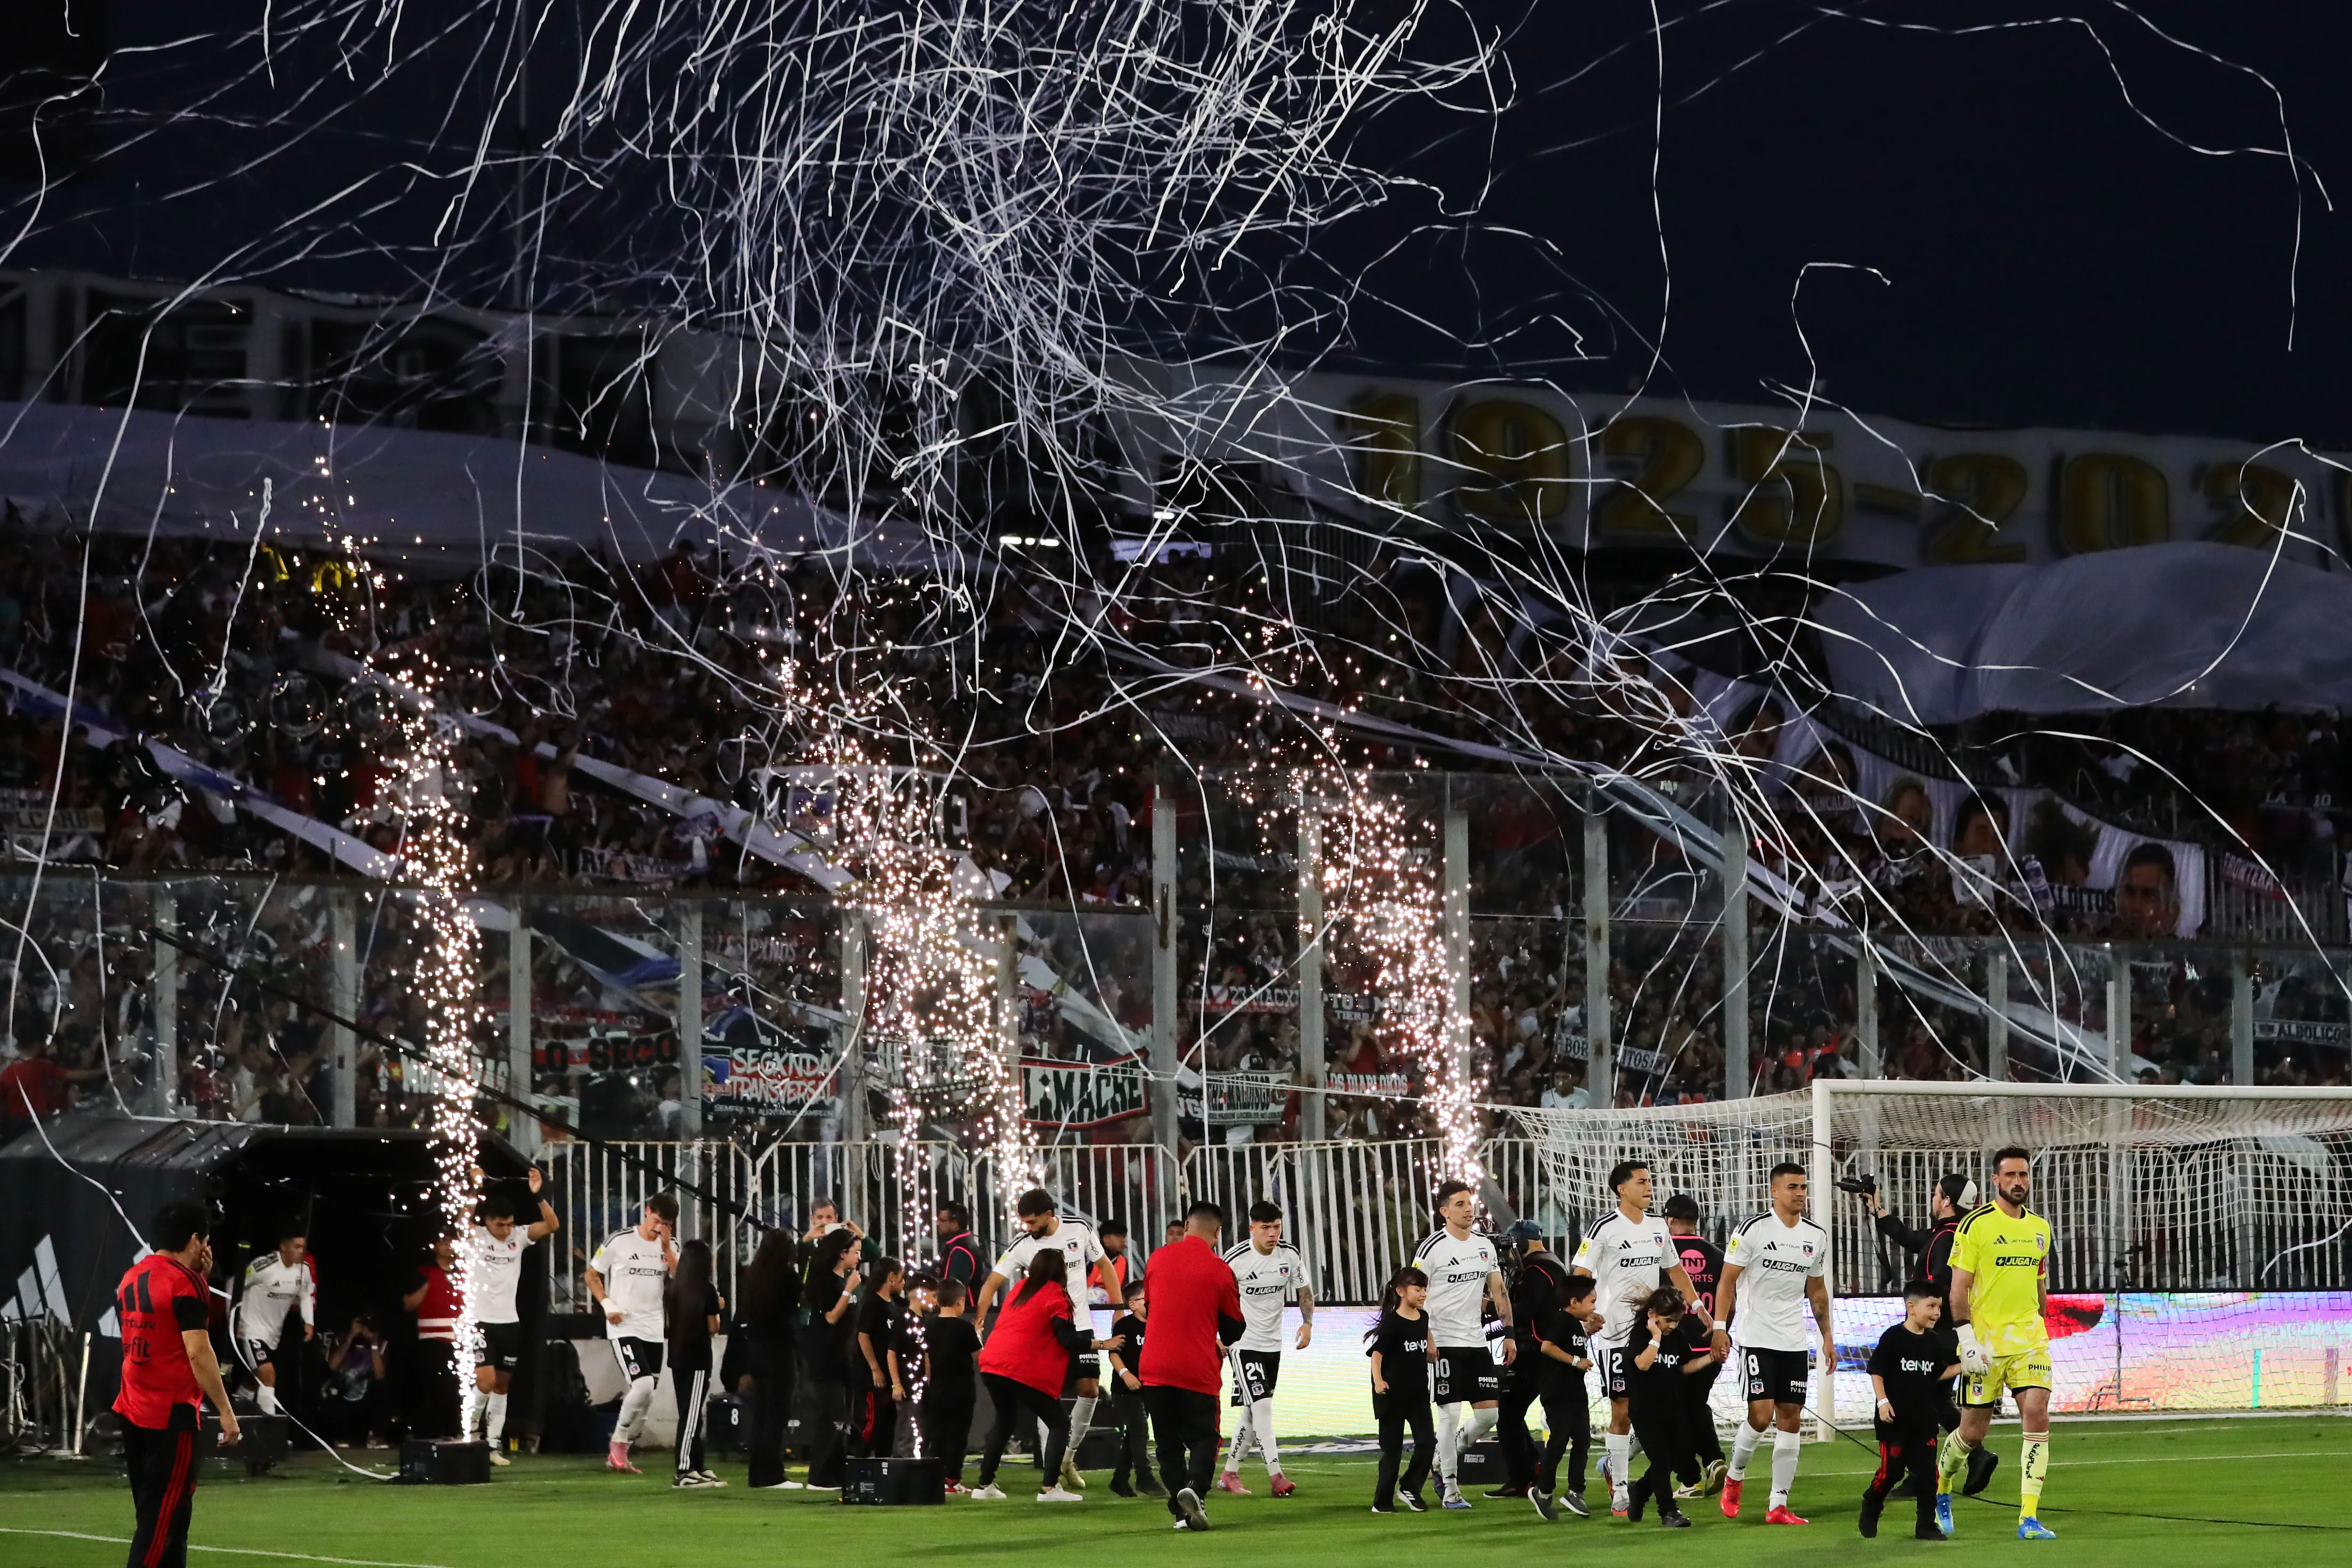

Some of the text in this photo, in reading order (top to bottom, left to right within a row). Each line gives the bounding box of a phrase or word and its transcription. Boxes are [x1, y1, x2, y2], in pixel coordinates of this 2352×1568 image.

[1343, 392, 2352, 563] 1925-202
[2050, 883, 2116, 914] ALDITOS
[588, 1033, 678, 1070] SECO
[732, 1047, 834, 1077] SEGXNDA
[1630, 1257, 1661, 1267] JUGABE
[2006, 1257, 2039, 1266] JUGABE
[1458, 1271, 1487, 1282] JUGABE
[1690, 1274, 1713, 1283] ORTS
[1245, 1362, 1266, 1381] 24
[1612, 1353, 1623, 1373] 2
[1748, 1354, 1759, 1376] 8
[731, 1408, 739, 1426] 8
